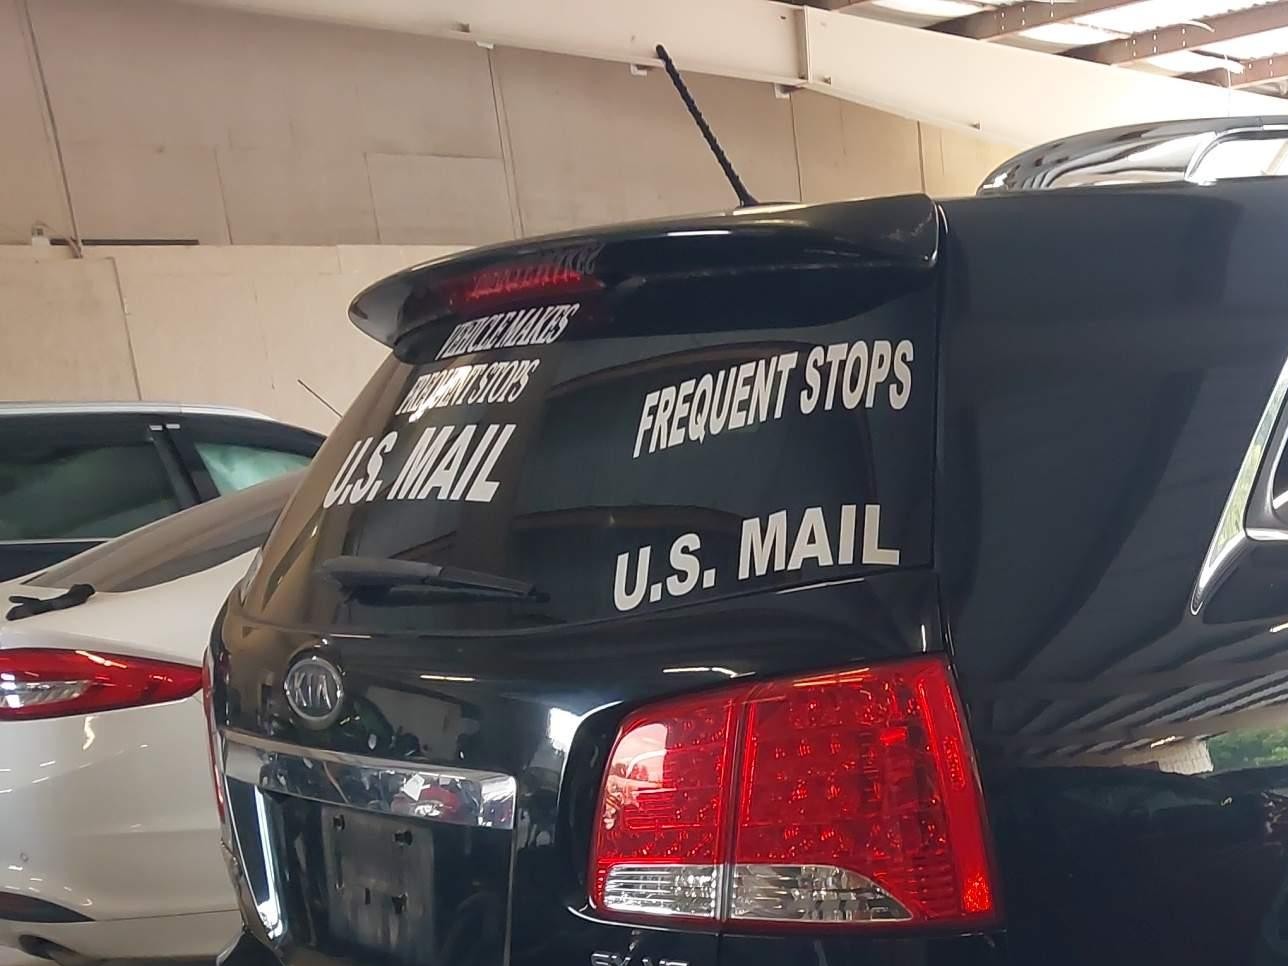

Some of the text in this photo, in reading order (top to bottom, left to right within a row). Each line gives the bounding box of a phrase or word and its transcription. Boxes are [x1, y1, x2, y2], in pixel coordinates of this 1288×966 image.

[435, 303, 580, 361] VEHICLE MAKES
[467, 359, 540, 405] STOPS
[632, 339, 914, 459] FREQUENT STOPS
[322, 424, 517, 508] U.S. MAIL
[613, 504, 900, 612] U.S. MAIL
[293, 671, 332, 710] KIA
